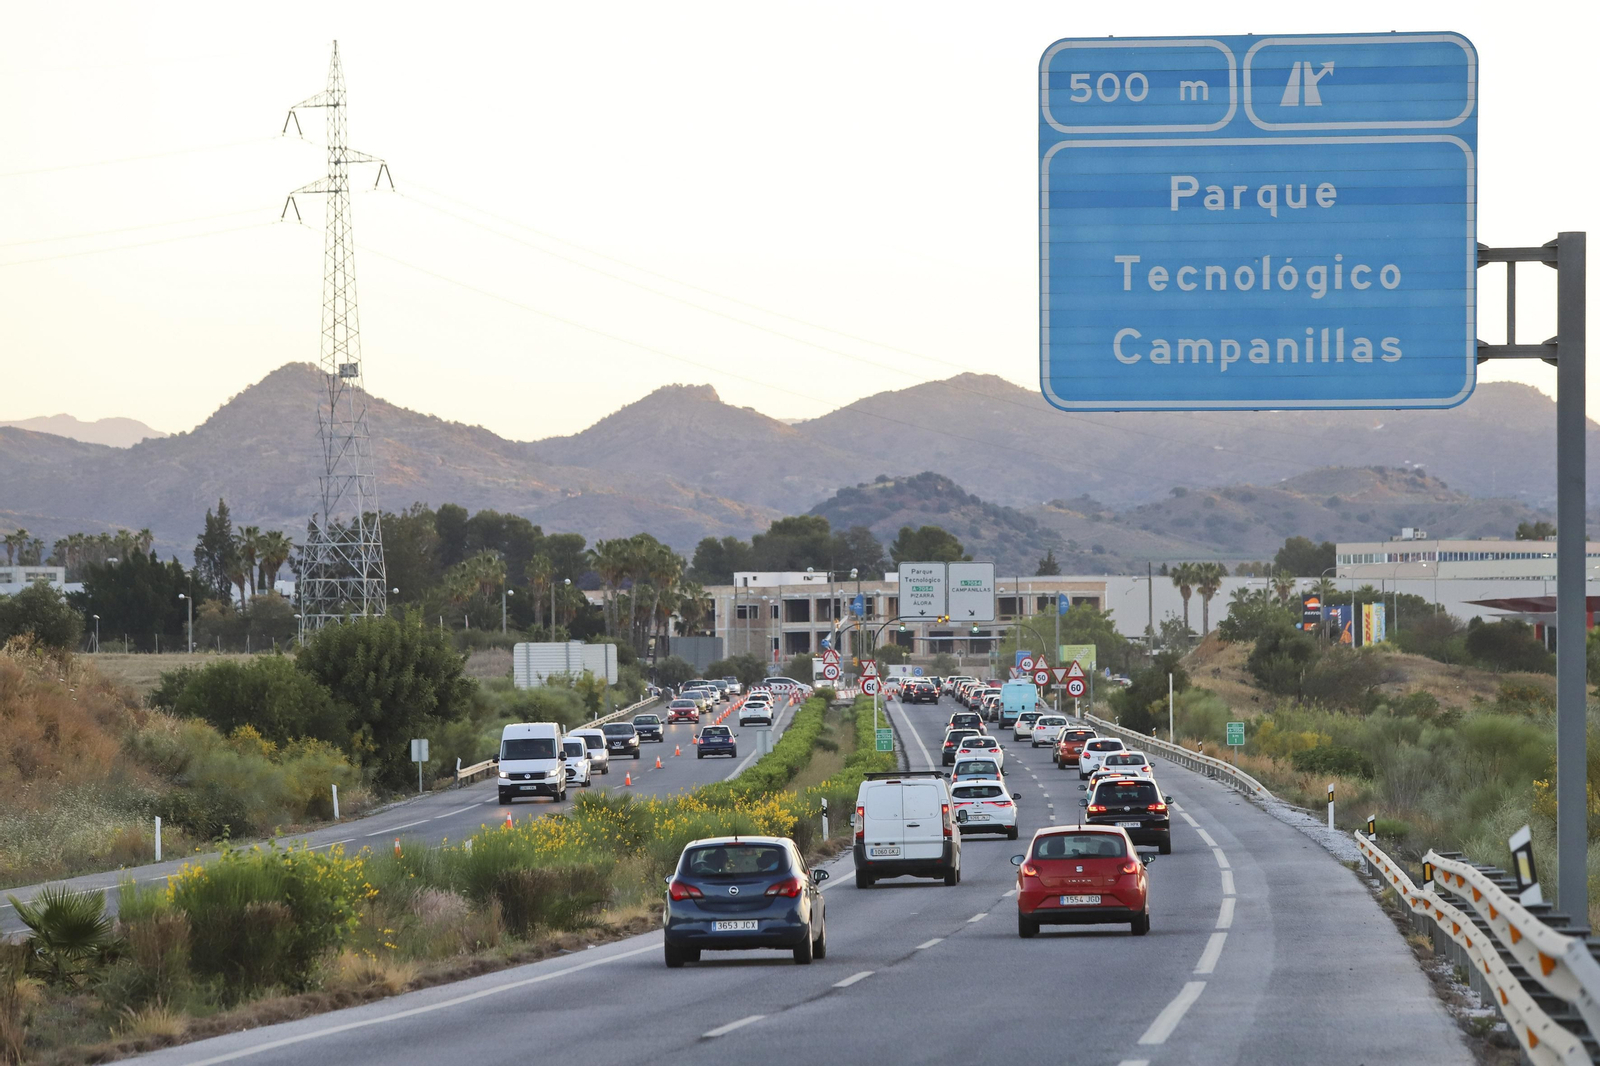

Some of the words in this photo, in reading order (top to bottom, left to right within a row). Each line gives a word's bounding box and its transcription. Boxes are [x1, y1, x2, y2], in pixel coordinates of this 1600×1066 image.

[1070, 72, 1149, 103] 500
[1179, 80, 1209, 101] m
[1170, 175, 1338, 218] Parque
[1114, 253, 1402, 300] Tecnológico
[1113, 327, 1403, 372] Campanillas
[718, 922, 738, 930] 3653
[740, 921, 756, 929] JCX
